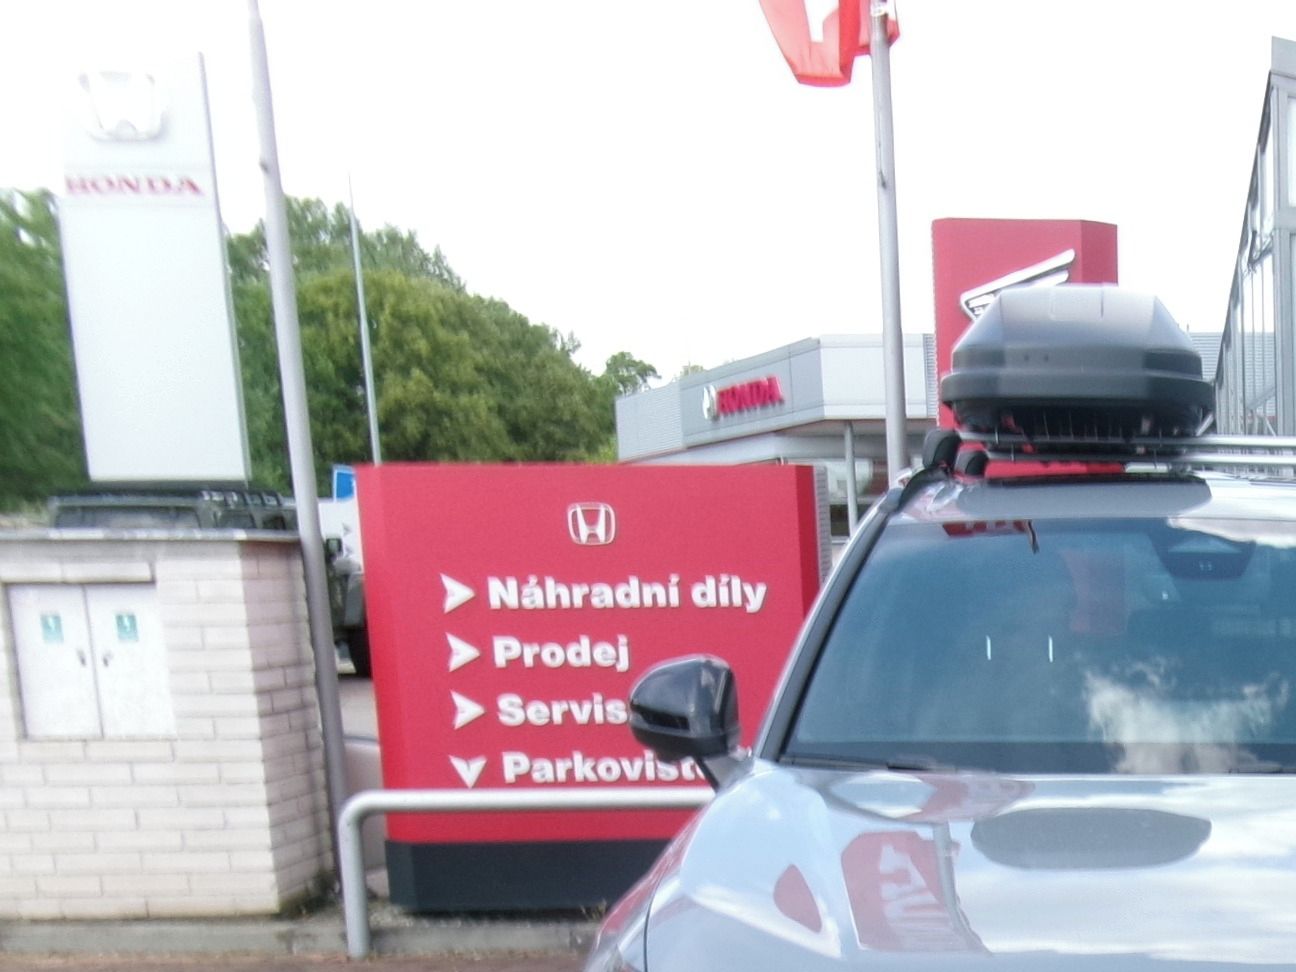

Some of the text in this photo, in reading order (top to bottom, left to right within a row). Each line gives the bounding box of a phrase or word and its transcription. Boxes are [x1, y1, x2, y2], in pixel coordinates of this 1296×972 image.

[64, 174, 206, 197] HONDA
[487, 573, 767, 614] Náhradní díly
[493, 634, 631, 673] Prodej
[497, 691, 629, 727] Servis
